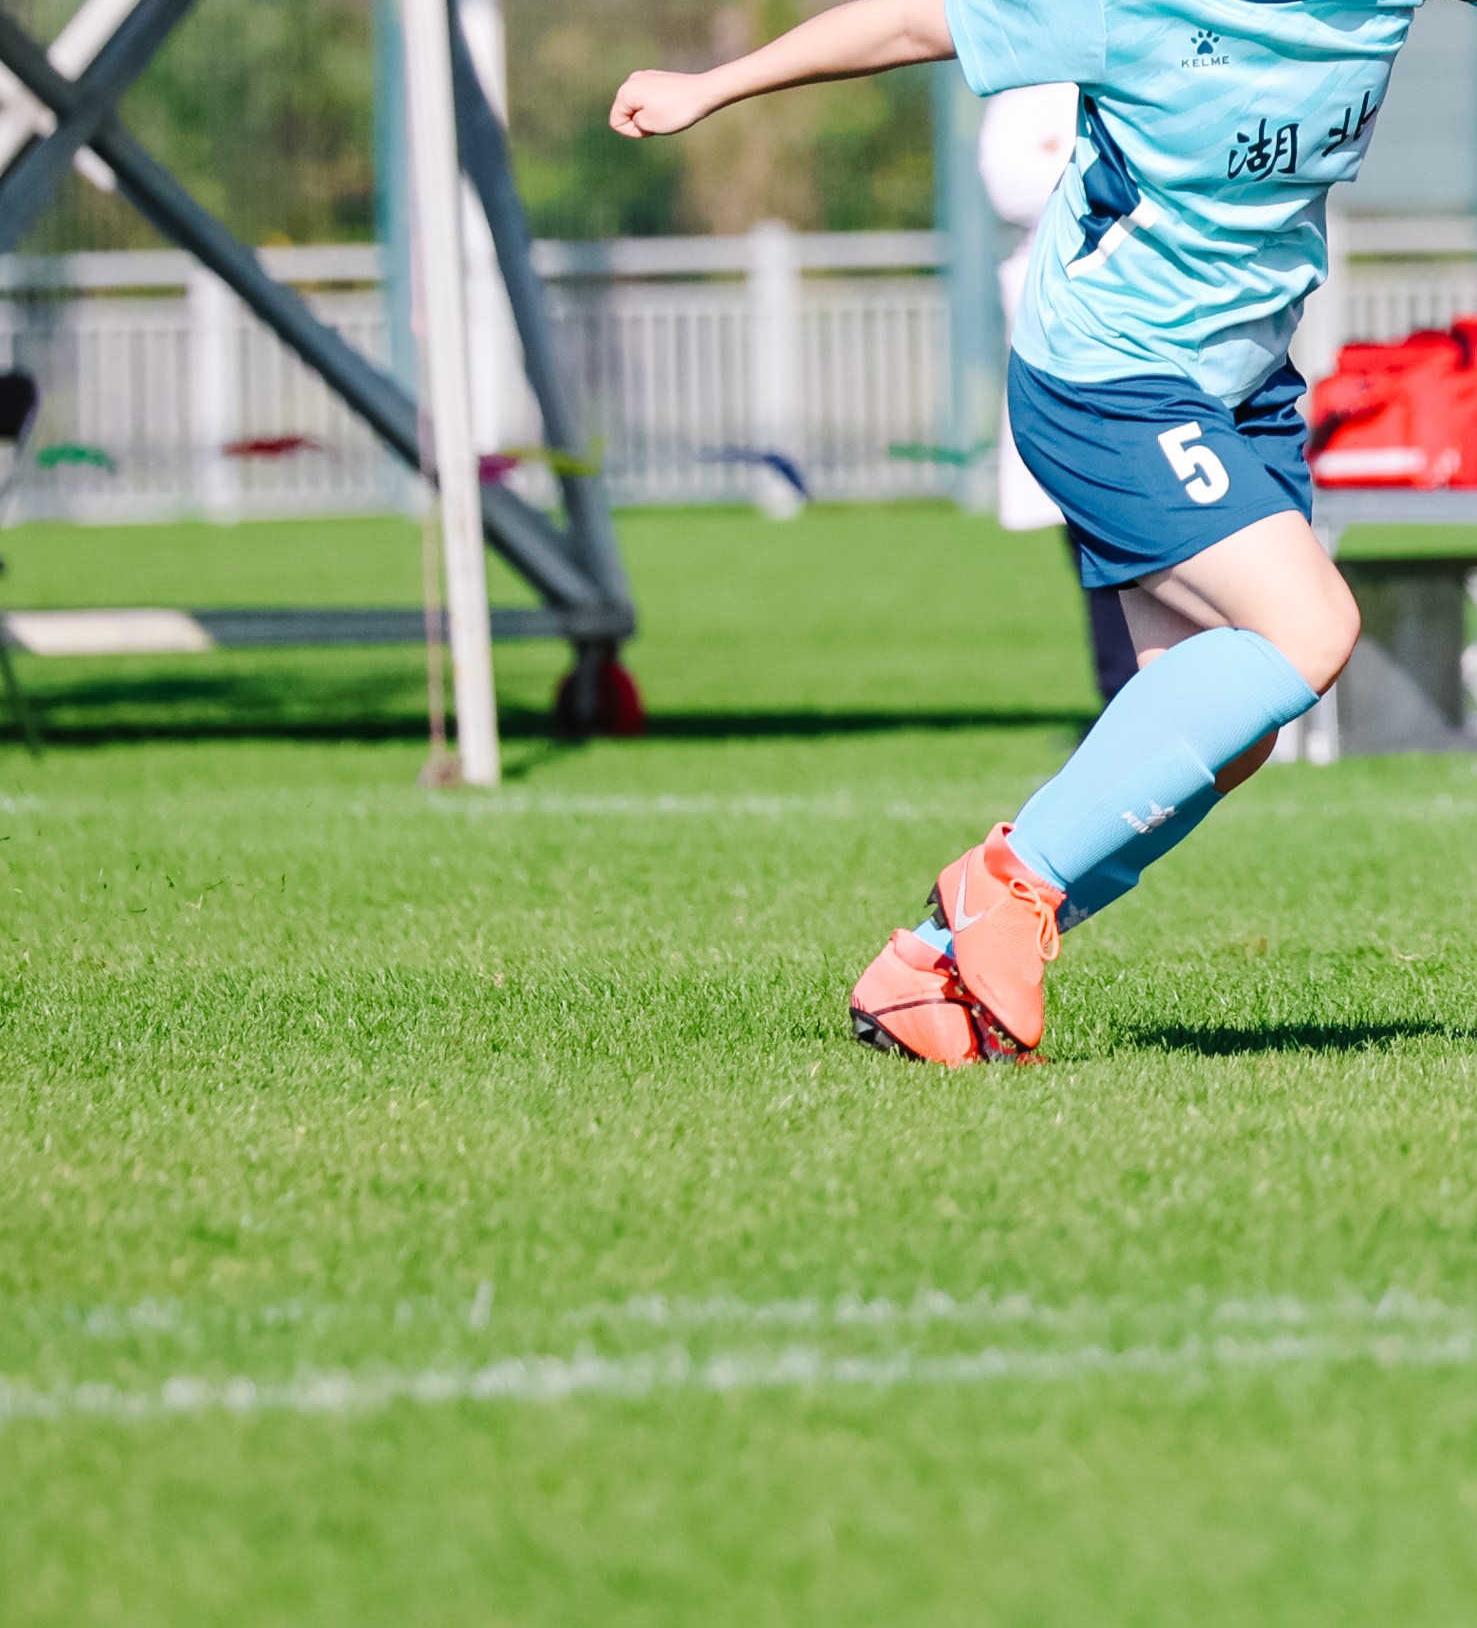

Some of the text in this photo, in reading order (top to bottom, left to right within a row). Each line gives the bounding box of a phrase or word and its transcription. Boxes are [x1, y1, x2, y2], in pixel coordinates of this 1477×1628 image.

[1181, 56, 1230, 68] KELME
[1227, 90, 1378, 182] 湖北
[1157, 421, 1230, 504] 5
